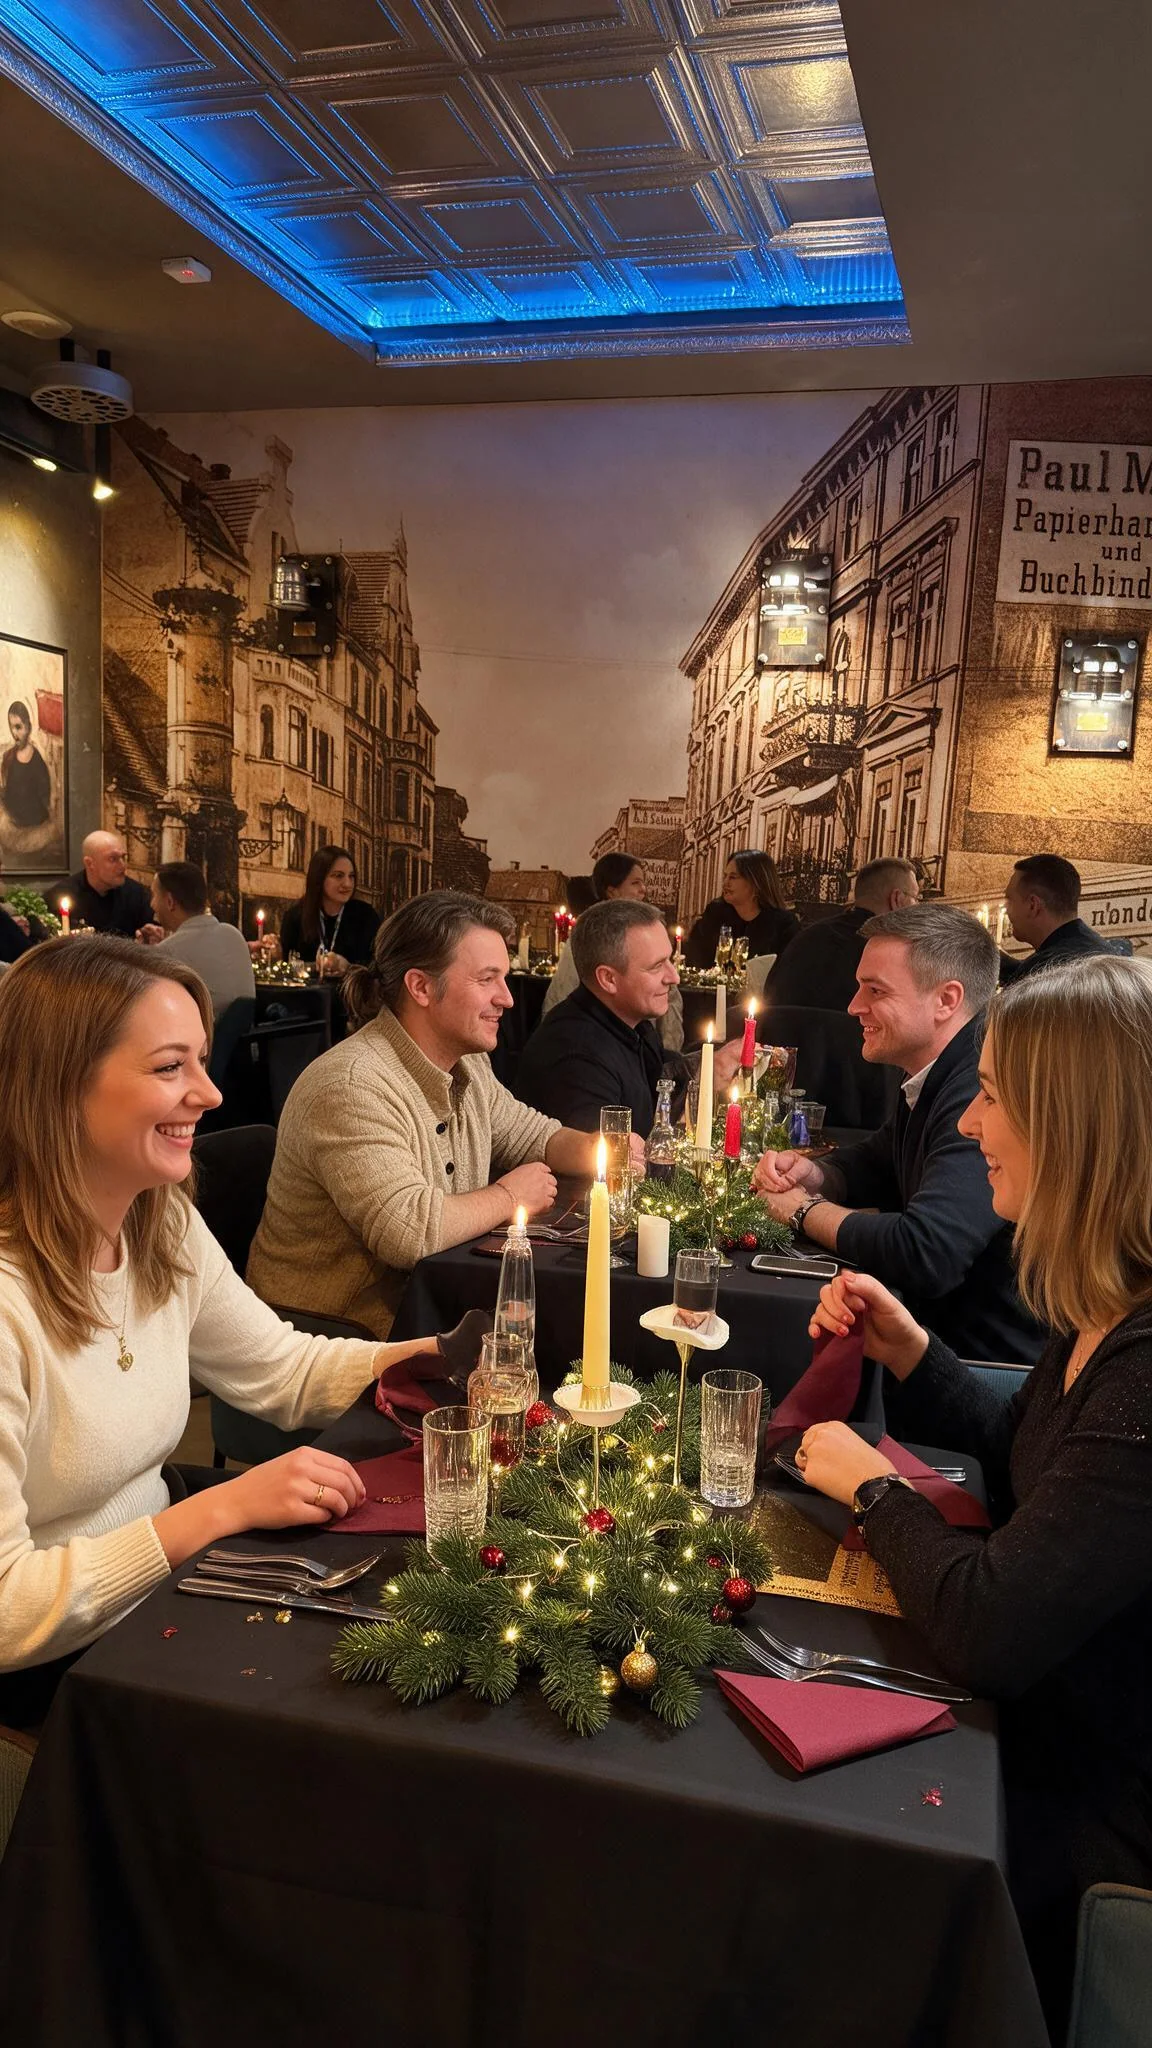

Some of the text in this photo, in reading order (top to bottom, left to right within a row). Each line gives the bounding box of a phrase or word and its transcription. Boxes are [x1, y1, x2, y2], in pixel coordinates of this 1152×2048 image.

[1017, 447, 1110, 492] Paul
[1101, 541, 1141, 562] und
[1018, 559, 1152, 599] Buchbind
